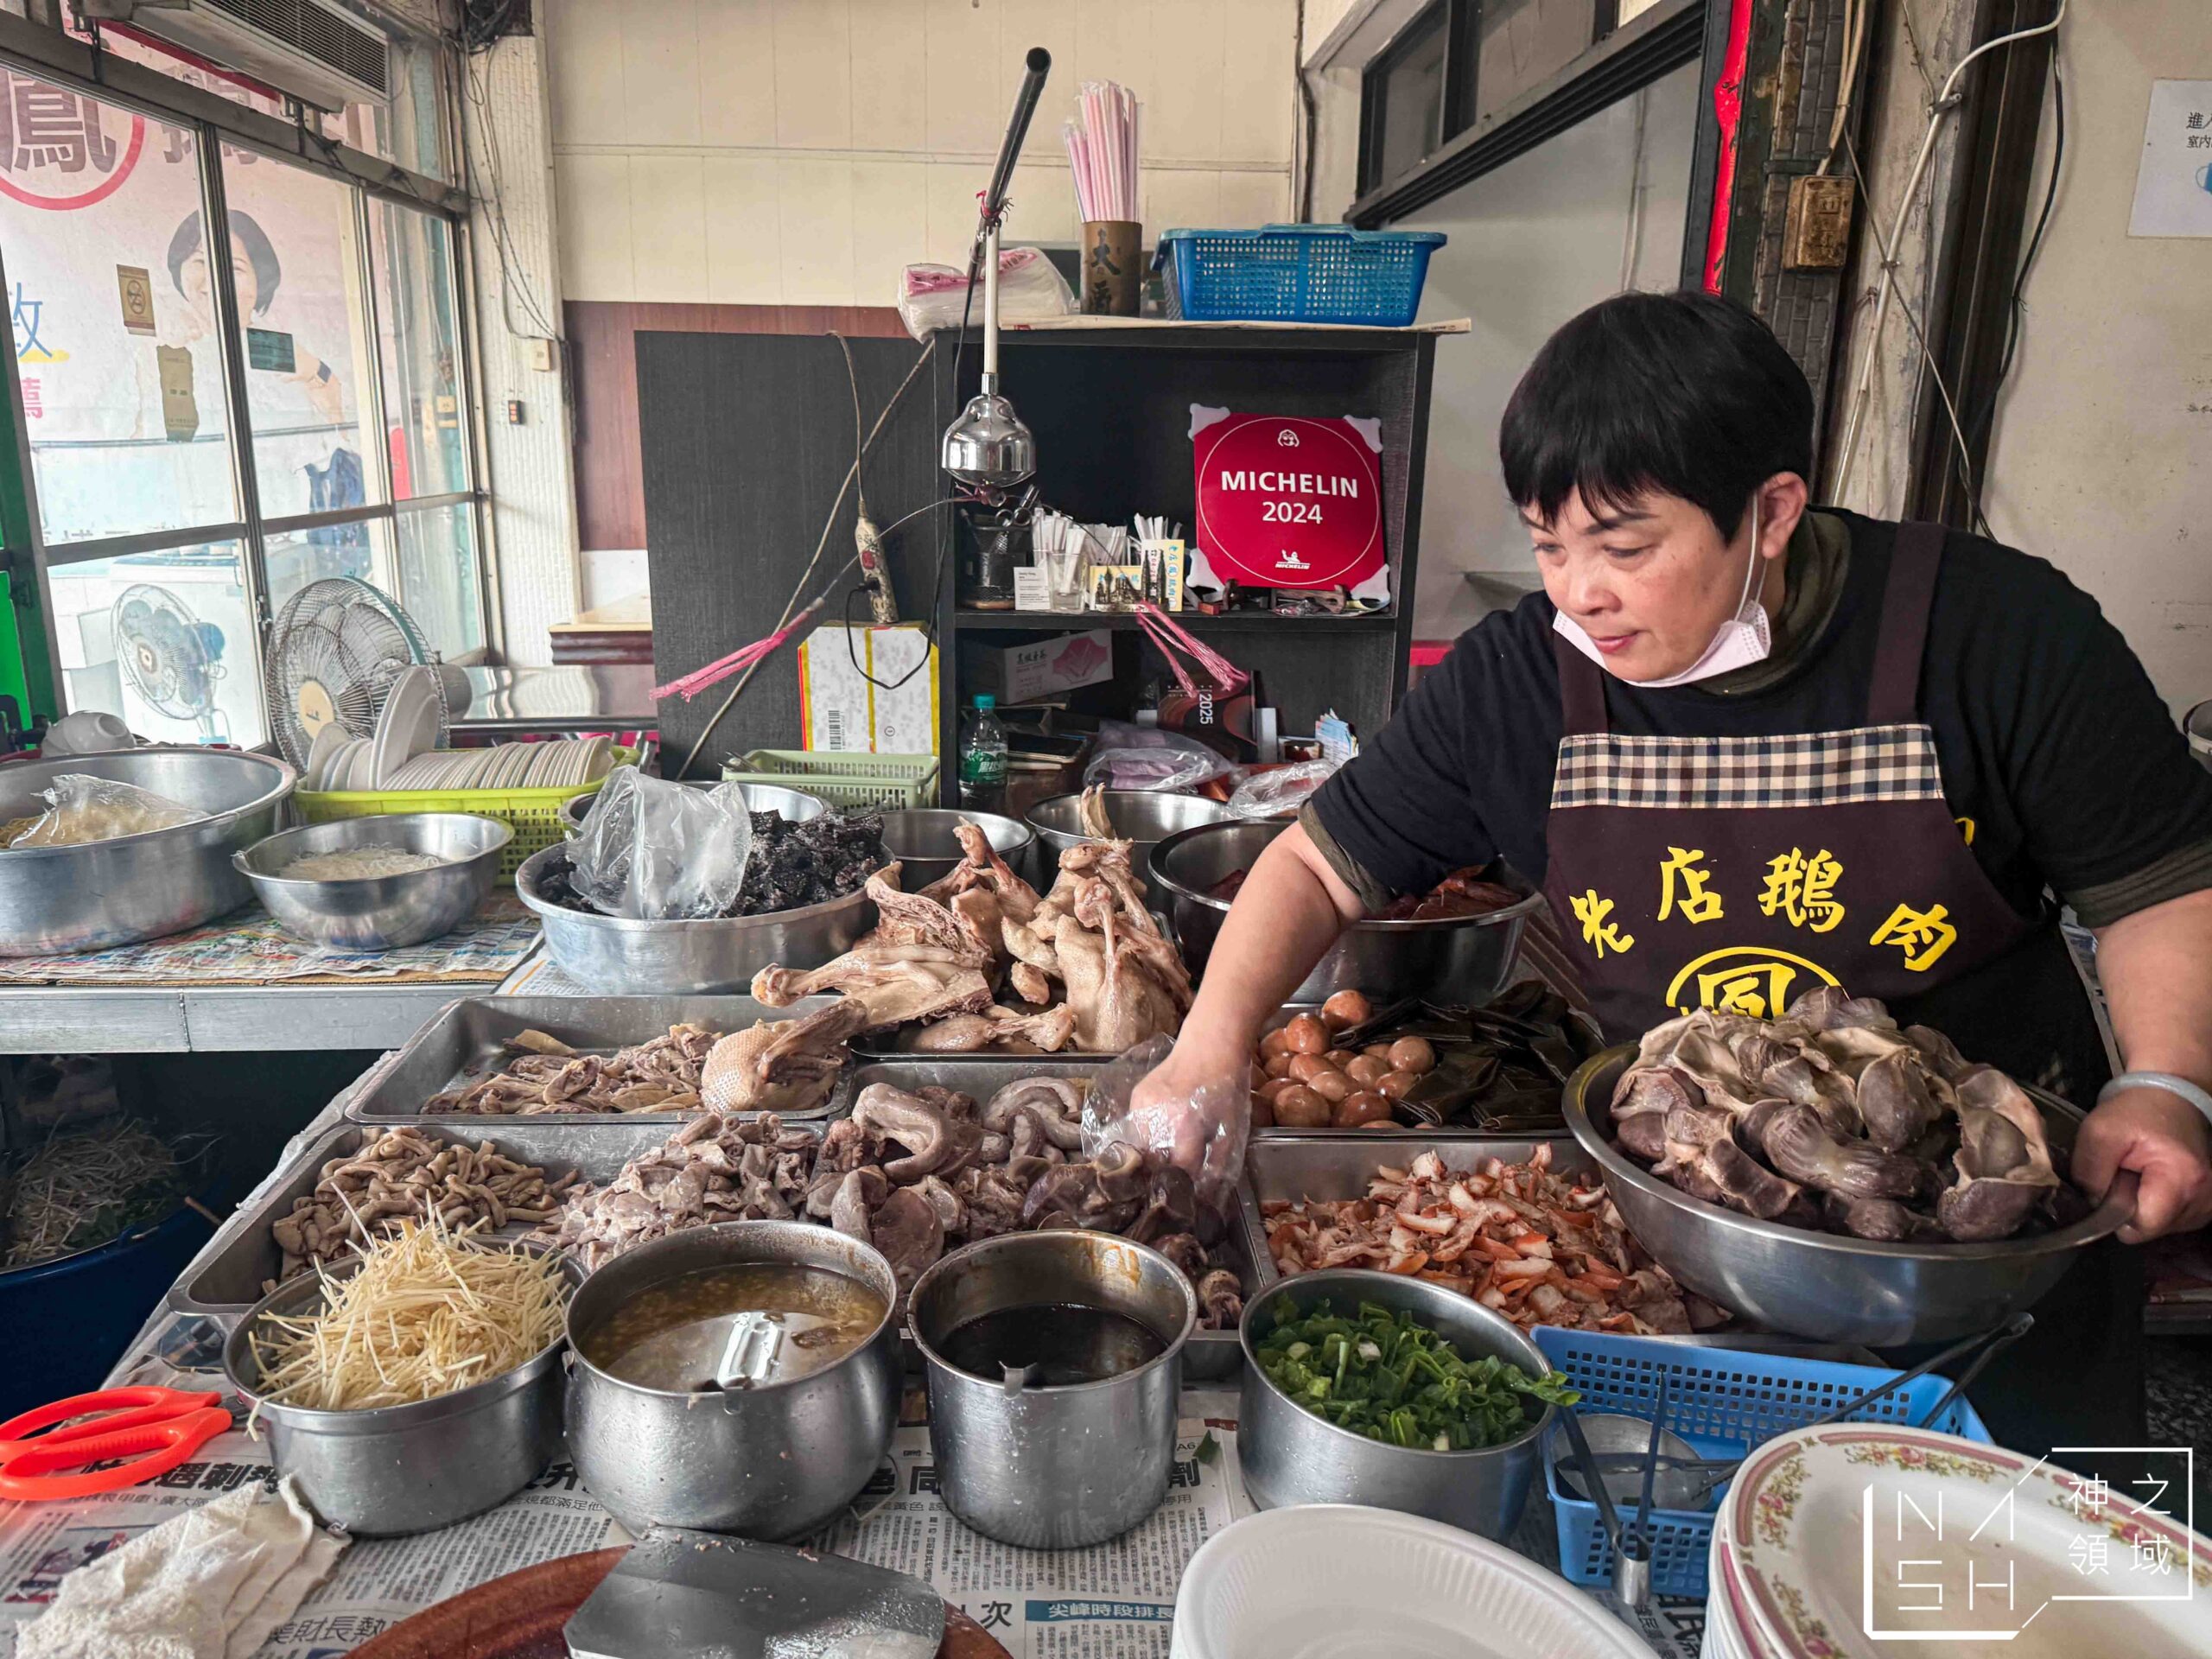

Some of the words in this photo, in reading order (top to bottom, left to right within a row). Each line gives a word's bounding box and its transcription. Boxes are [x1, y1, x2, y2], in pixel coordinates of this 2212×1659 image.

[2186, 134, 2212, 149] 室內
[1221, 471, 1358, 499] MICHELIN
[1262, 501, 1323, 524] 2024
[1198, 693, 1213, 725] 2025
[1177, 1442, 1196, 1452] A6
[270, 1615, 401, 1644] 財長熱
